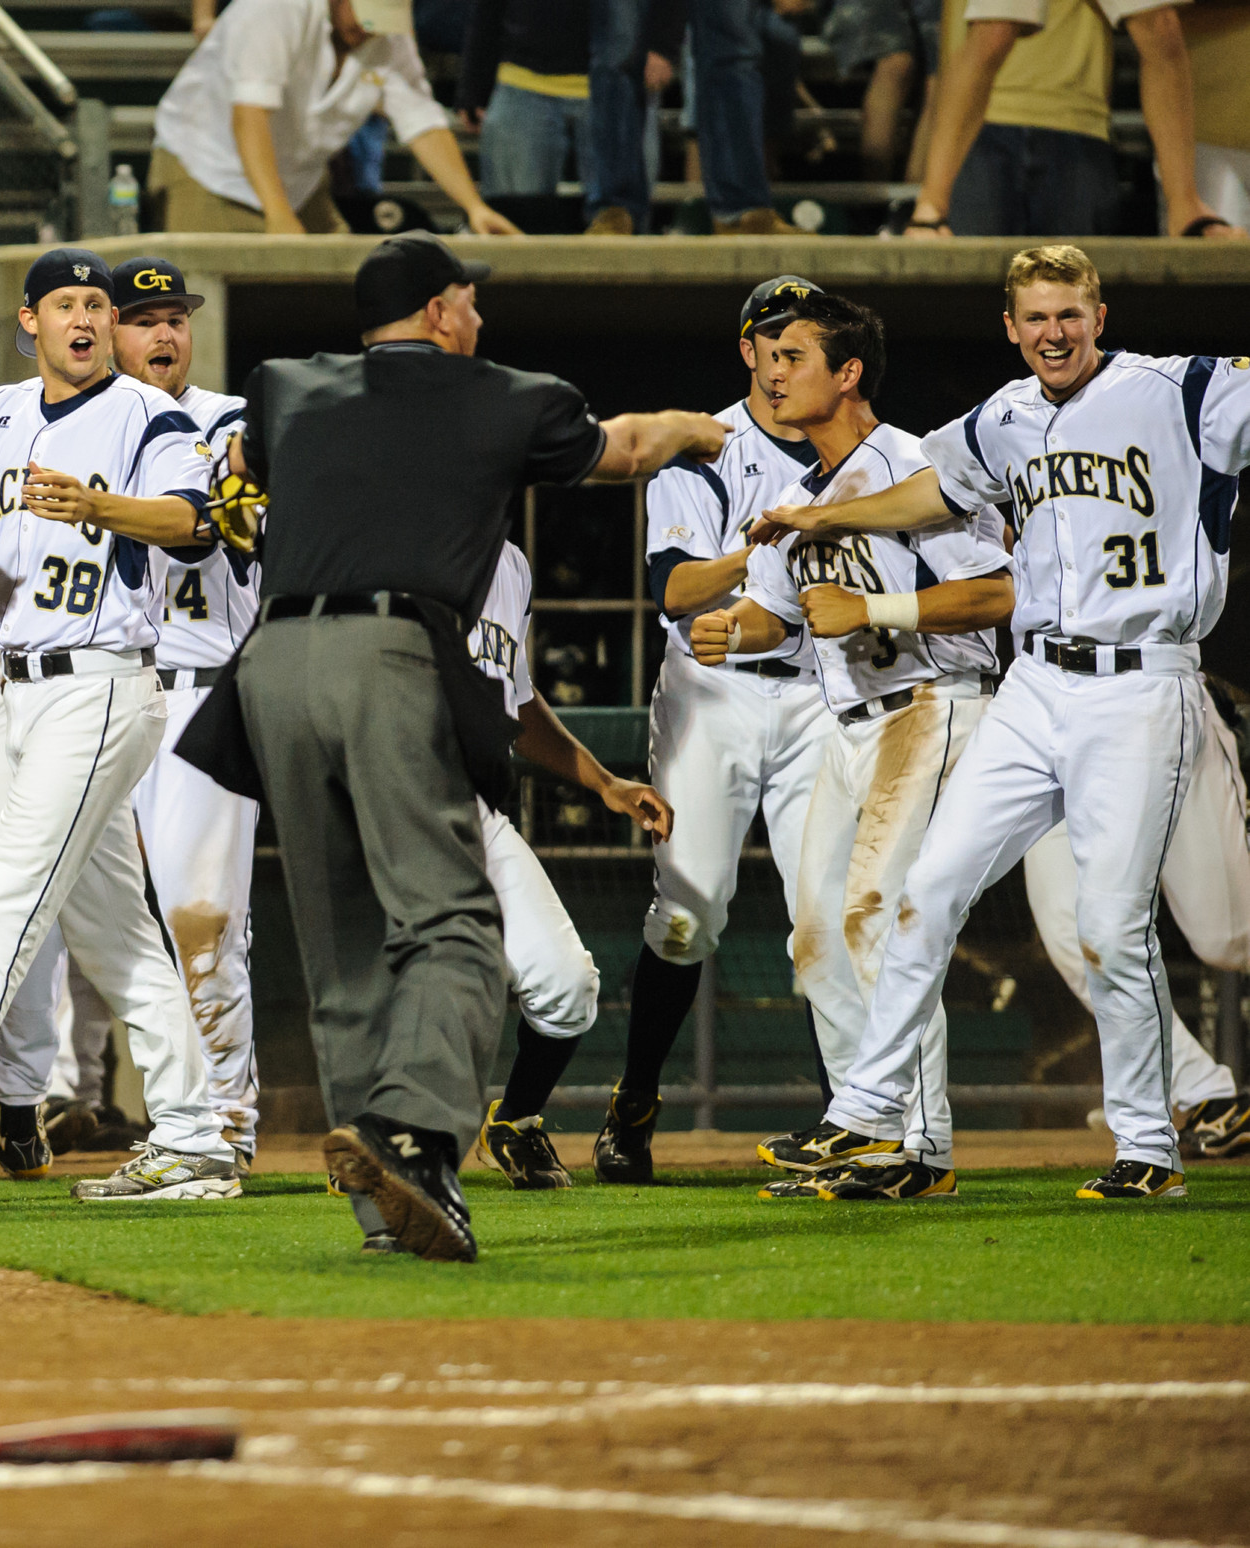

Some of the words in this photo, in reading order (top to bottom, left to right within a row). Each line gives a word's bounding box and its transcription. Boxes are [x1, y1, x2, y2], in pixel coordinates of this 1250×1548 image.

[133, 268, 172, 290] GT
[745, 463, 758, 473] R
[34, 555, 103, 617] 38
[1103, 530, 1167, 590] 31
[164, 568, 209, 623] 4
